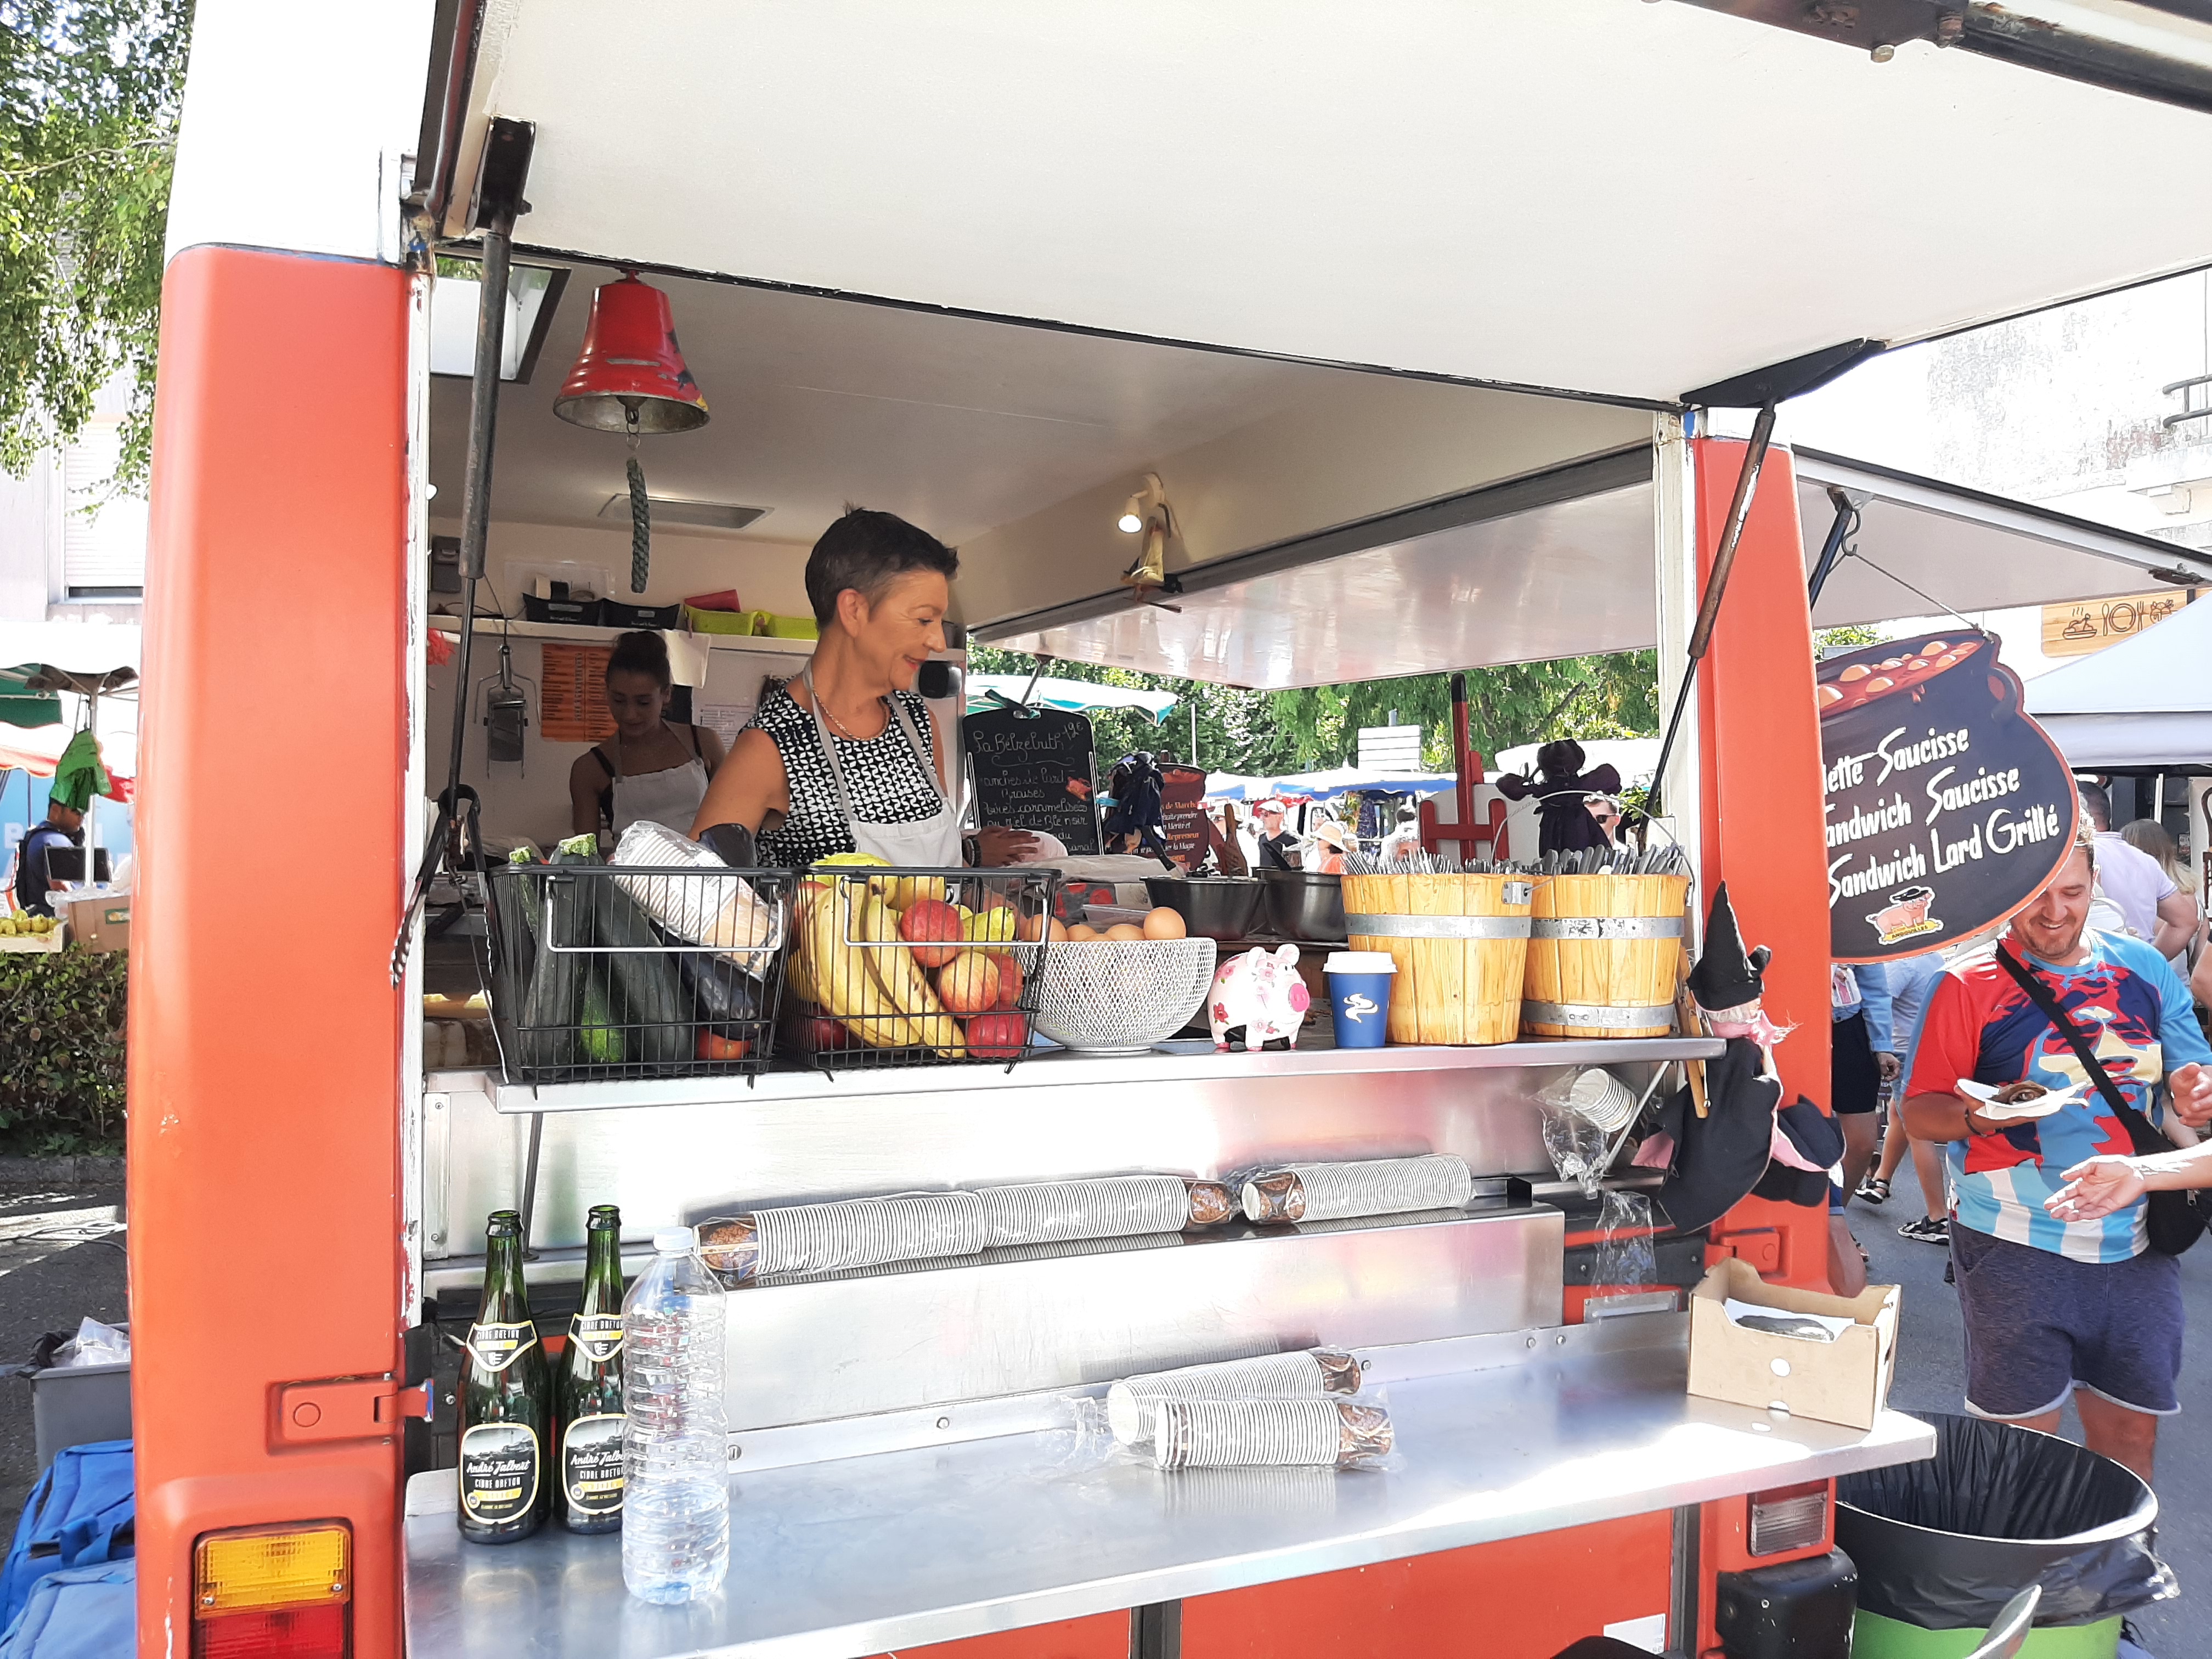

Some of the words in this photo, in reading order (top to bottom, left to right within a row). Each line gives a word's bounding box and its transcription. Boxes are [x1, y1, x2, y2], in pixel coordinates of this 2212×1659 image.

[1876, 727, 1970, 787] Saucisse
[1825, 792, 1912, 848] andwich
[1925, 765, 2021, 826] Saucisse
[1828, 843, 1927, 909] Sandwich
[1930, 822, 1984, 874] Lard
[1985, 803, 2060, 854] Grillé
[466, 1460, 495, 1474] André
[571, 1453, 600, 1466] André
